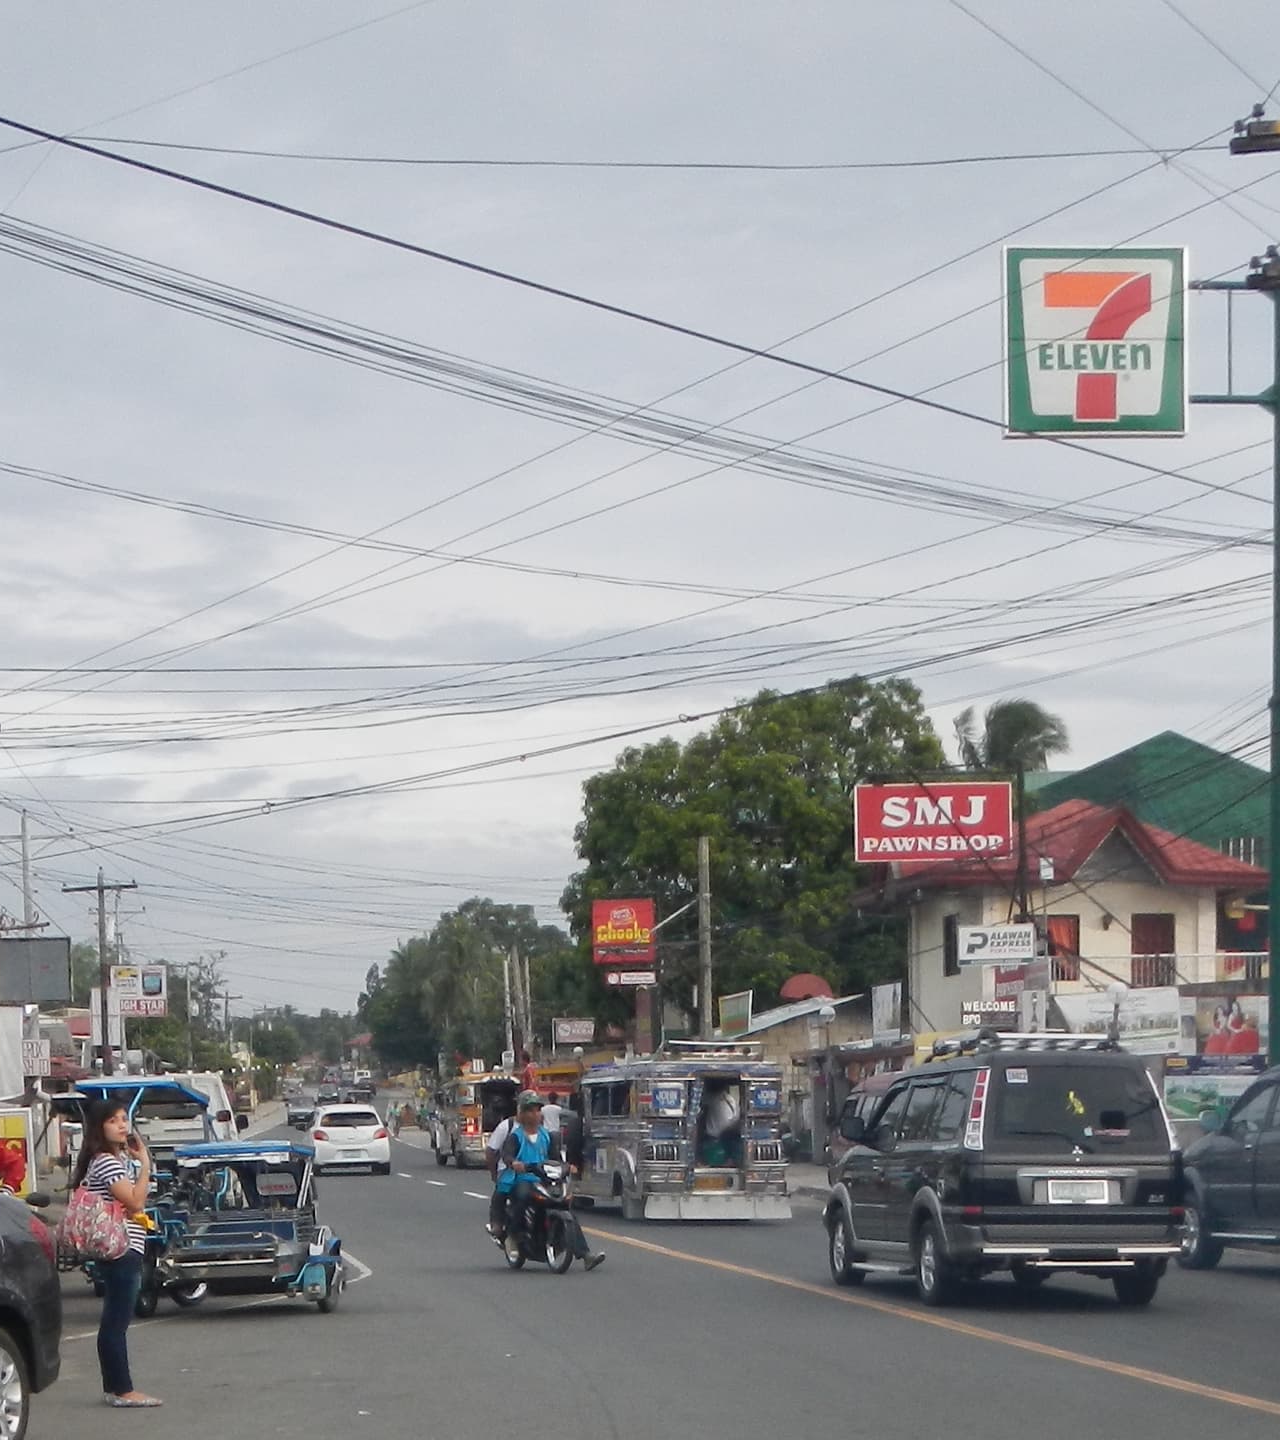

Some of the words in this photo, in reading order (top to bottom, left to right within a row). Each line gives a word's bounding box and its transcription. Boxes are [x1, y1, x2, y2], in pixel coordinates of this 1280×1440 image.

[1043, 272, 1152, 340] 7
[881, 796, 987, 828] SMJ
[863, 834, 1004, 853] PAWNSHOP
[990, 940, 1032, 949] EXPRESS
[120, 999, 137, 1010] IGH
[140, 999, 165, 1011] STAR
[962, 1001, 1015, 1012] WELCOME
